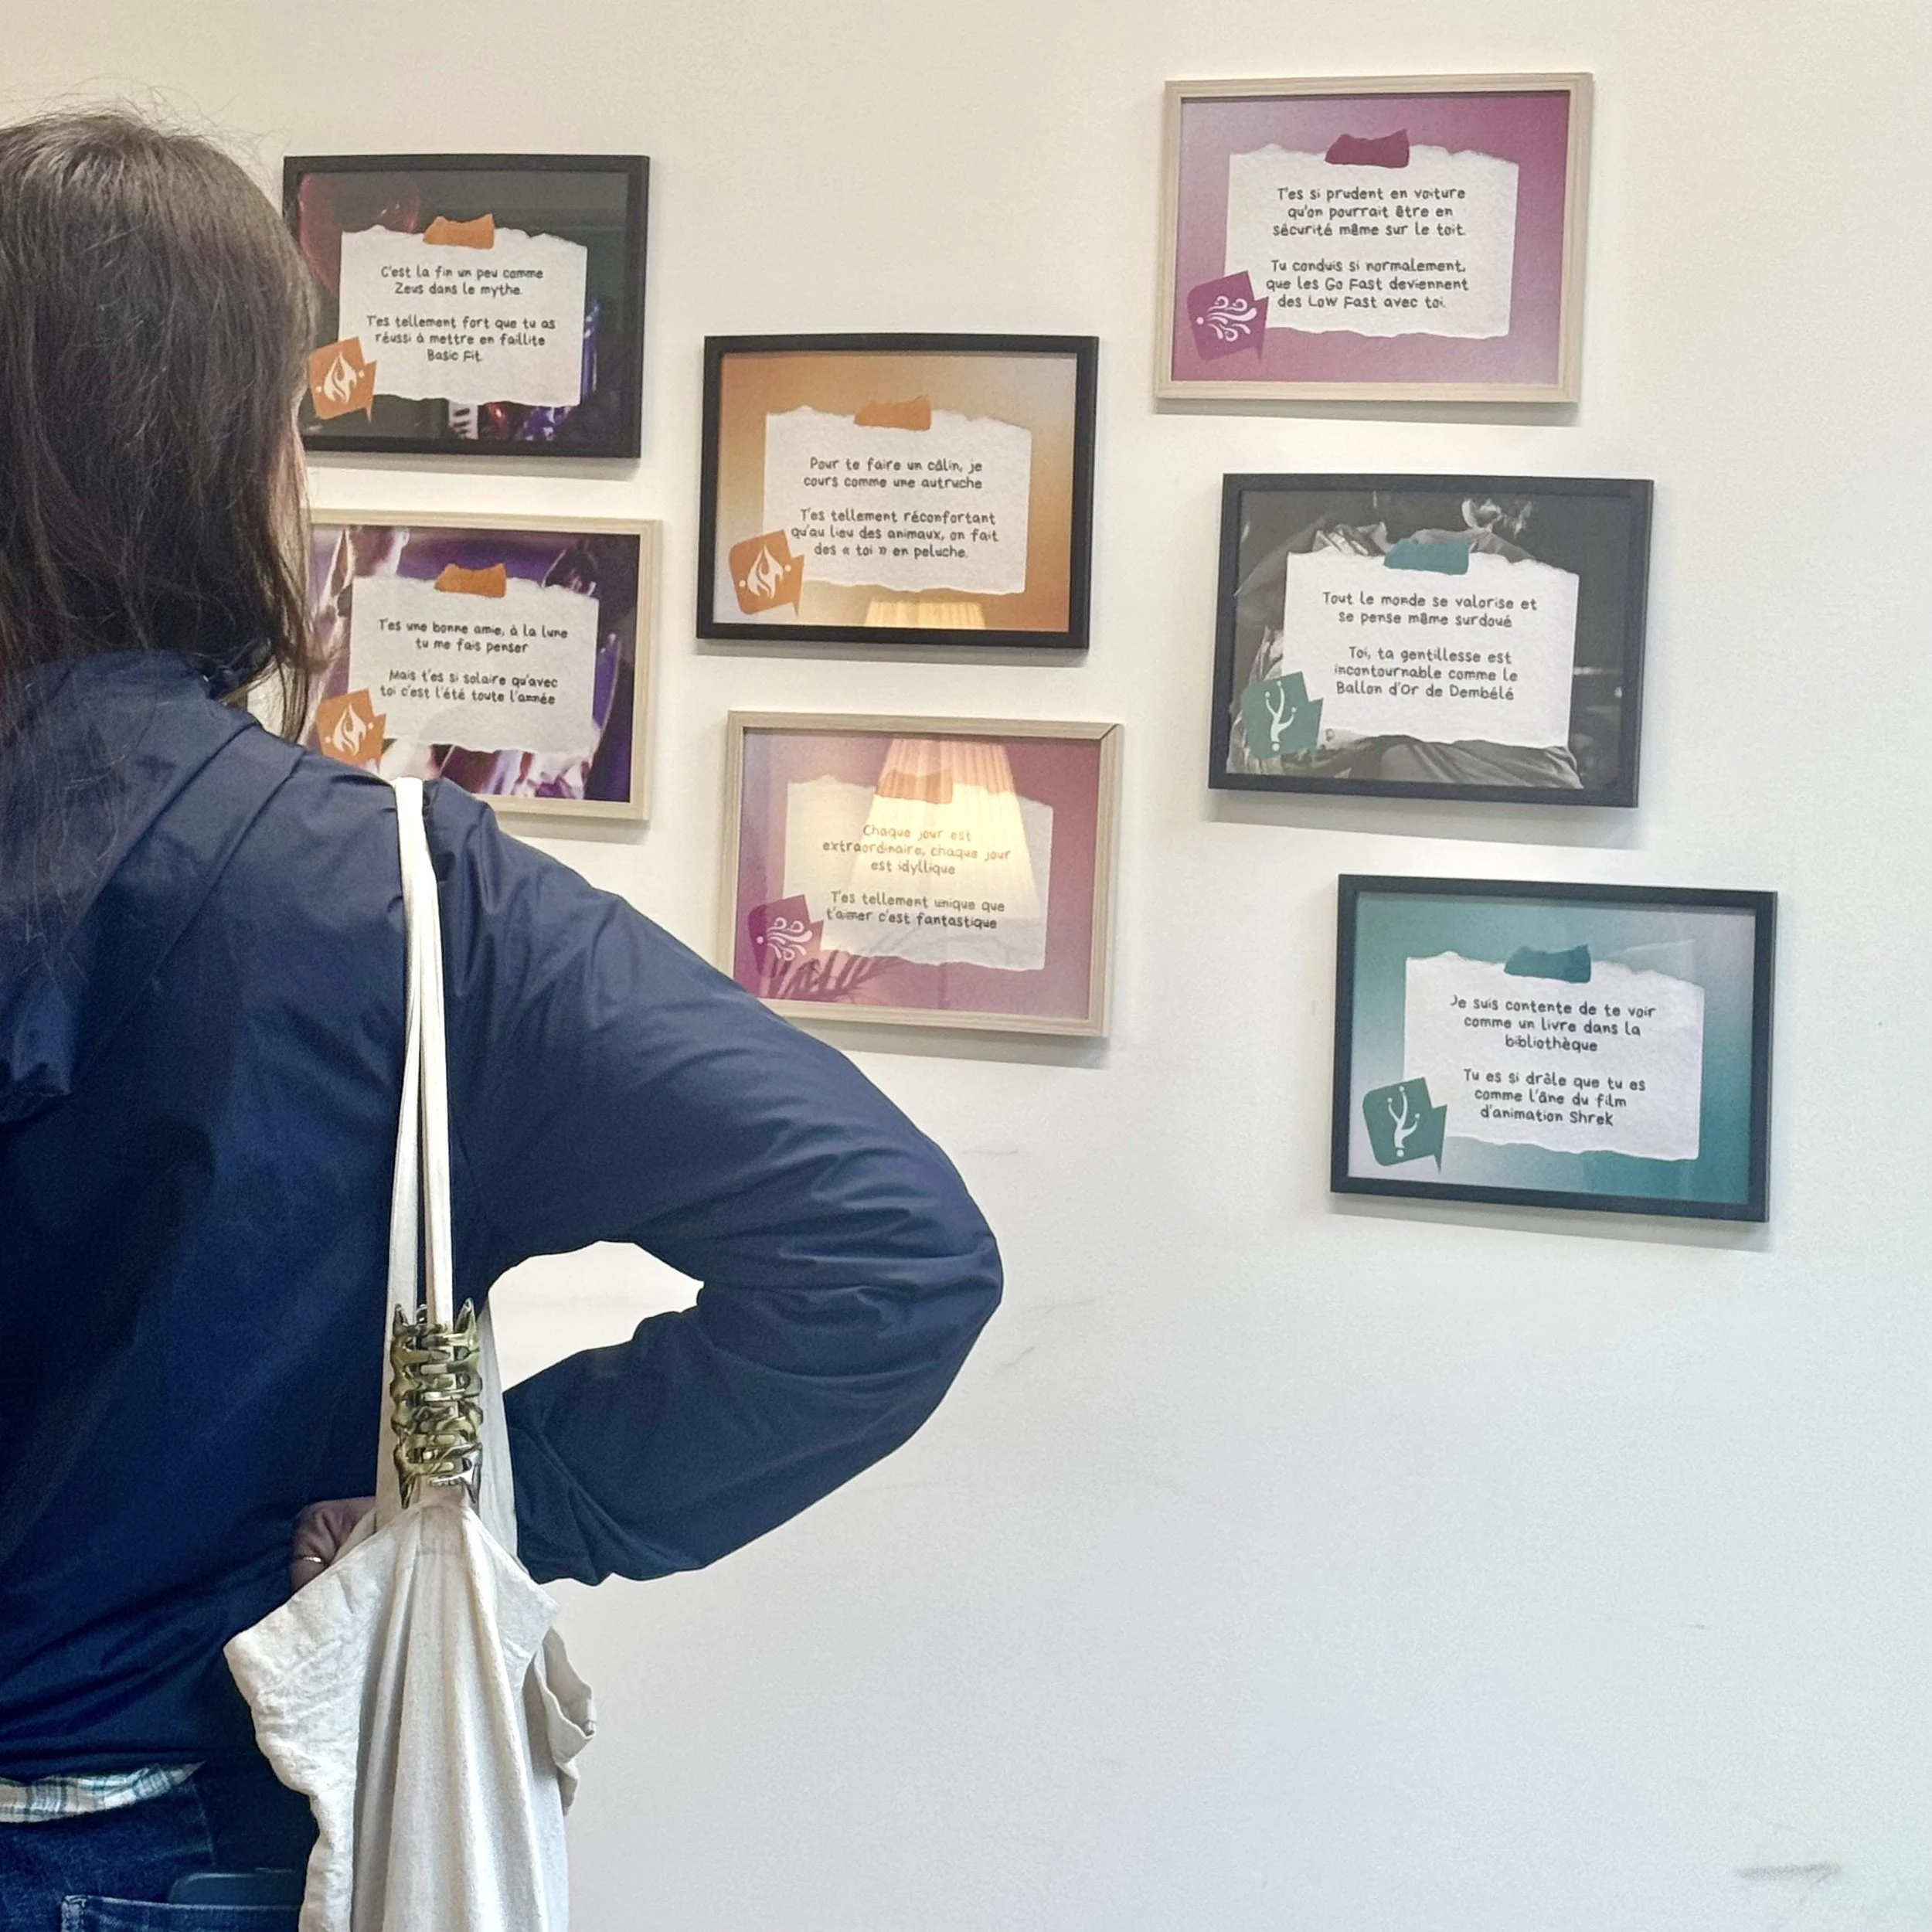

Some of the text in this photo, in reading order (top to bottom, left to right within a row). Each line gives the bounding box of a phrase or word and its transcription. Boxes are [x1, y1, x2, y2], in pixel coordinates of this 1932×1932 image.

[1277, 186, 1465, 202] T'es si prudent en voiture
[1287, 204, 1453, 219] qu'on pourrait être en
[1273, 223, 1332, 236] sécurité
[1339, 223, 1379, 236] même
[1385, 224, 1408, 236] sur
[1415, 222, 1430, 236] le
[381, 266, 411, 278] C'est
[417, 266, 430, 277] la
[435, 266, 453, 278] fin
[477, 269, 498, 281] peu
[503, 270, 543, 278] comme
[1271, 260, 1287, 271] Tu
[1292, 258, 1342, 272] conduis
[1349, 260, 1359, 272] si
[395, 282, 423, 294] Zeus
[429, 283, 457, 294] dans
[463, 282, 474, 294] le
[1266, 276, 1468, 292] que les Go Fast deviennent
[1277, 294, 1446, 309] des Low Fast avec toi.
[366, 315, 556, 329] T'es tellement fort que tu as
[375, 332, 545, 346] réussi à mettre en faillite
[427, 349, 458, 361] Basic
[810, 456, 839, 470] Pour
[845, 459, 859, 470] te
[867, 457, 901, 471] faire
[927, 459, 962, 473] câlin,
[968, 462, 982, 474] je
[804, 476, 982, 489] cours comme une autruche
[801, 507, 995, 526] T'es tellement réconfortant
[791, 526, 998, 543] qu'au lieu des animaux, on fait
[815, 543, 836, 555] des
[855, 544, 872, 556] toi
[893, 547, 909, 556] en
[1323, 590, 1536, 611] Tout le monde se valorise et
[379, 618, 568, 638] T'es une bonne amie, à la lune
[1338, 611, 1512, 628] se pense même surdoué
[416, 638, 529, 654] tu me fais penser
[1349, 646, 1512, 665] Toi, ta gentillesse est
[389, 669, 557, 688] Mais t'es si solaire qu'avec
[1335, 665, 1518, 682] incontournable comme le
[380, 685, 555, 705] toi c'est l'été toute l'année
[1337, 681, 1514, 700] Ballon d'Or de Dembélé
[862, 825, 971, 842] Chaque jour est
[822, 839, 1011, 862] extraordinaire, chaque jour
[871, 860, 955, 876] est idyllique
[832, 890, 1005, 913] T'es tellement unique que
[826, 906, 997, 930] t'aimer c'est fantastique
[1450, 995, 1656, 1019] Je suis contente de te voir
[1464, 1016, 1640, 1036] comme un livre dans la
[1505, 1032, 1598, 1053] bibliothèque
[1464, 1068, 1645, 1091] Tu es si drôle que tu es
[1475, 1088, 1626, 1107] comme l'âne du film
[1480, 1104, 1614, 1126] d'animation Shrek
